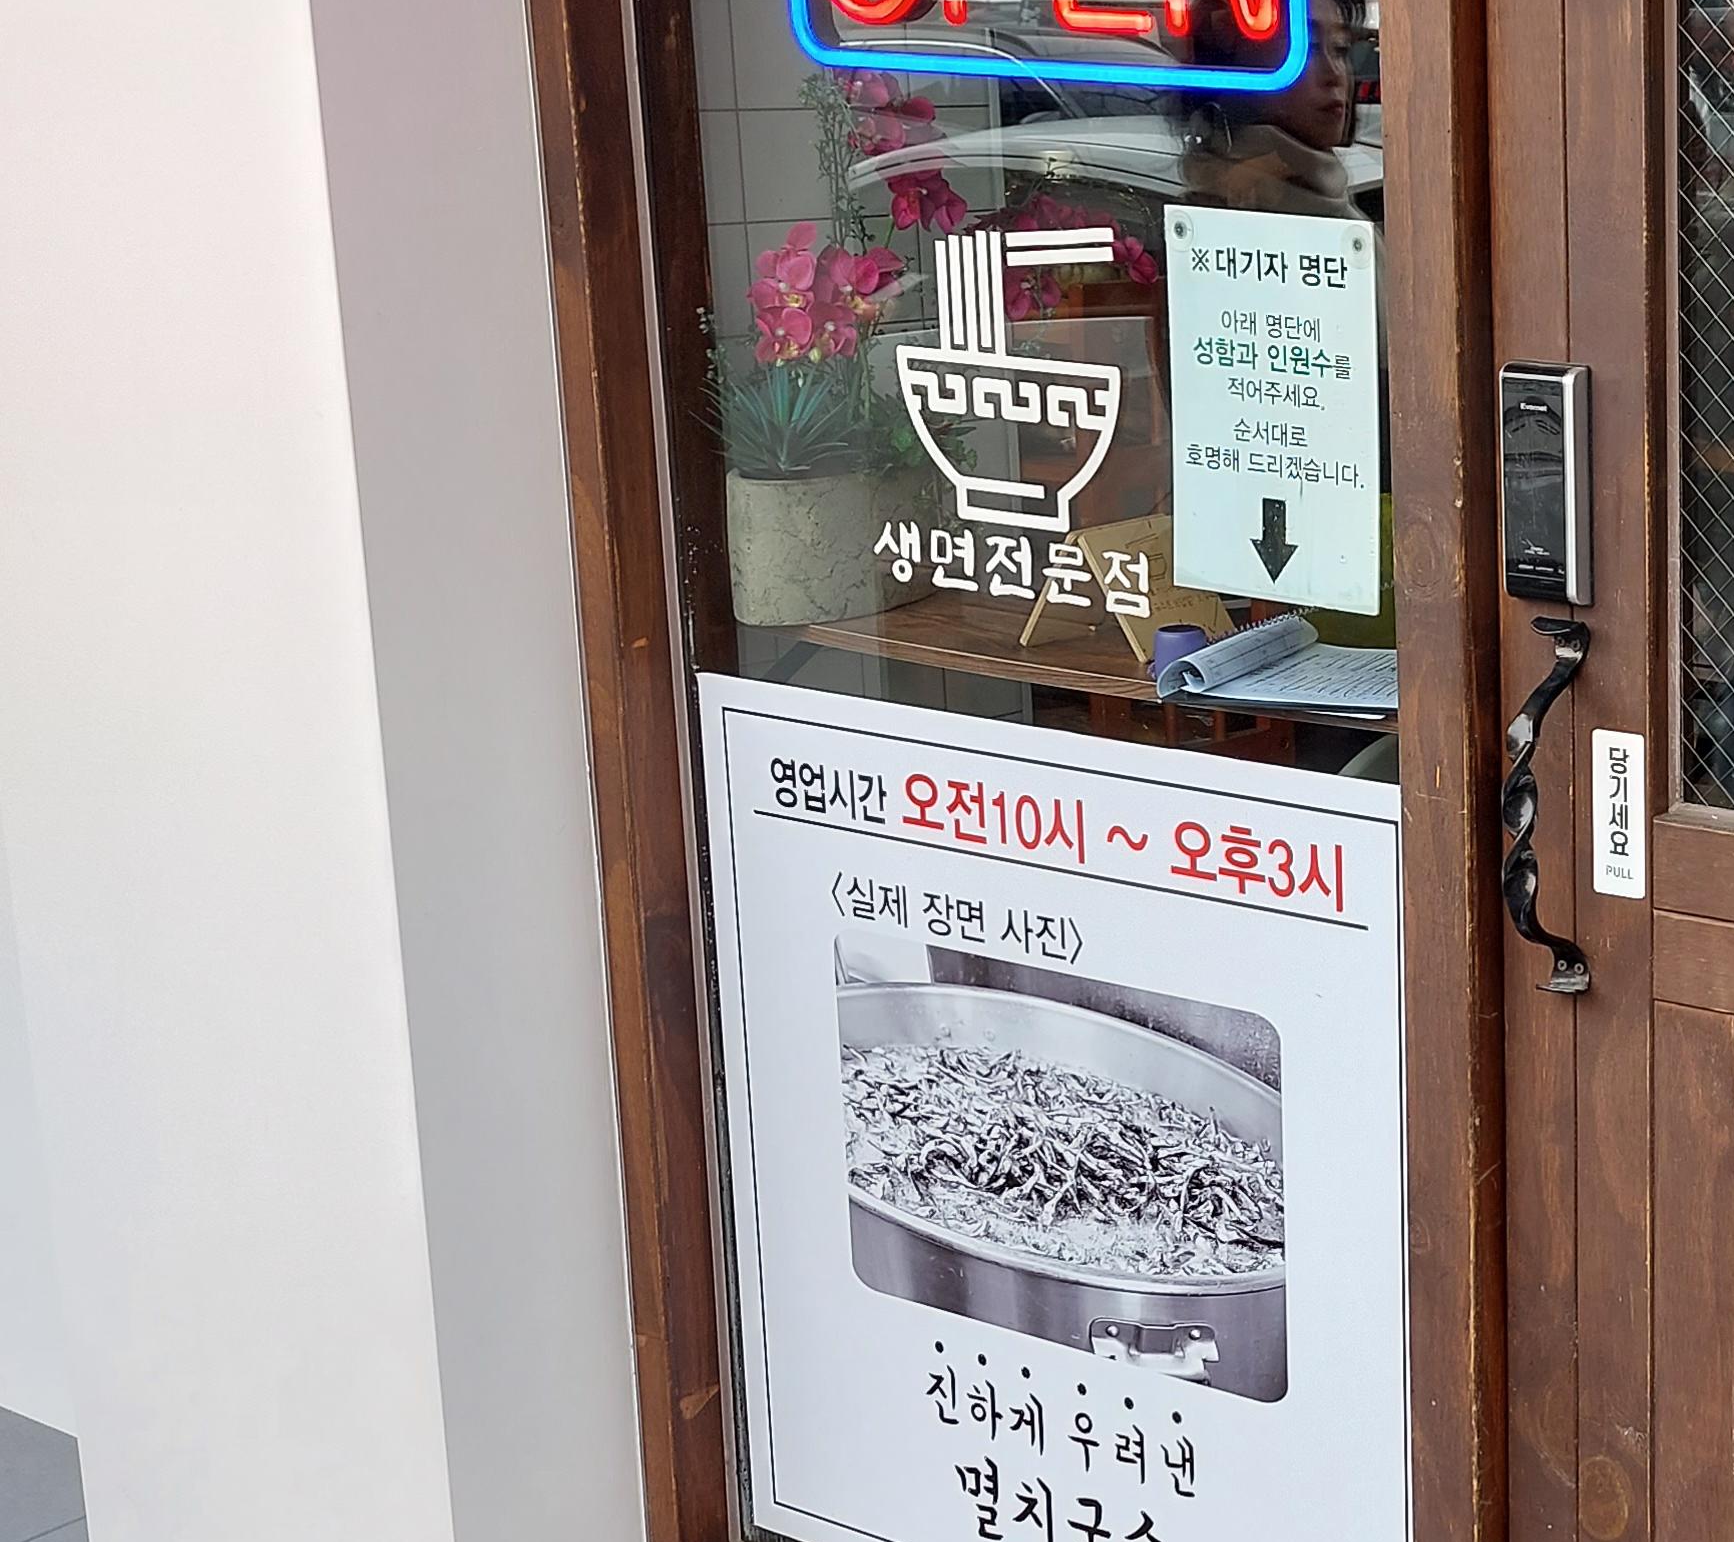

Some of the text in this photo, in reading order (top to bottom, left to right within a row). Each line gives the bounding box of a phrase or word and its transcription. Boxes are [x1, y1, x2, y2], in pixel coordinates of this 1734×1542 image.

[1299, 254, 1348, 289] 명단
[1220, 310, 1321, 343] 아래 명단에
[1193, 337, 1351, 380] 성함과 인원수를
[1228, 378, 1326, 411] 적어주세요.
[1233, 418, 1308, 448] 순서대로
[1186, 443, 1365, 490] 호명해 드리겠습니다.
[873, 520, 1151, 619] 생면전문점
[1608, 746, 1630, 857] 당기세요
[770, 756, 887, 825] 영업시간
[902, 772, 1086, 865] 오전10시
[1170, 822, 1344, 913] 오후3시
[1605, 865, 1634, 880] PULL
[922, 890, 986, 944] 장면
[925, 1365, 1196, 1498] 진하게 우려낸
